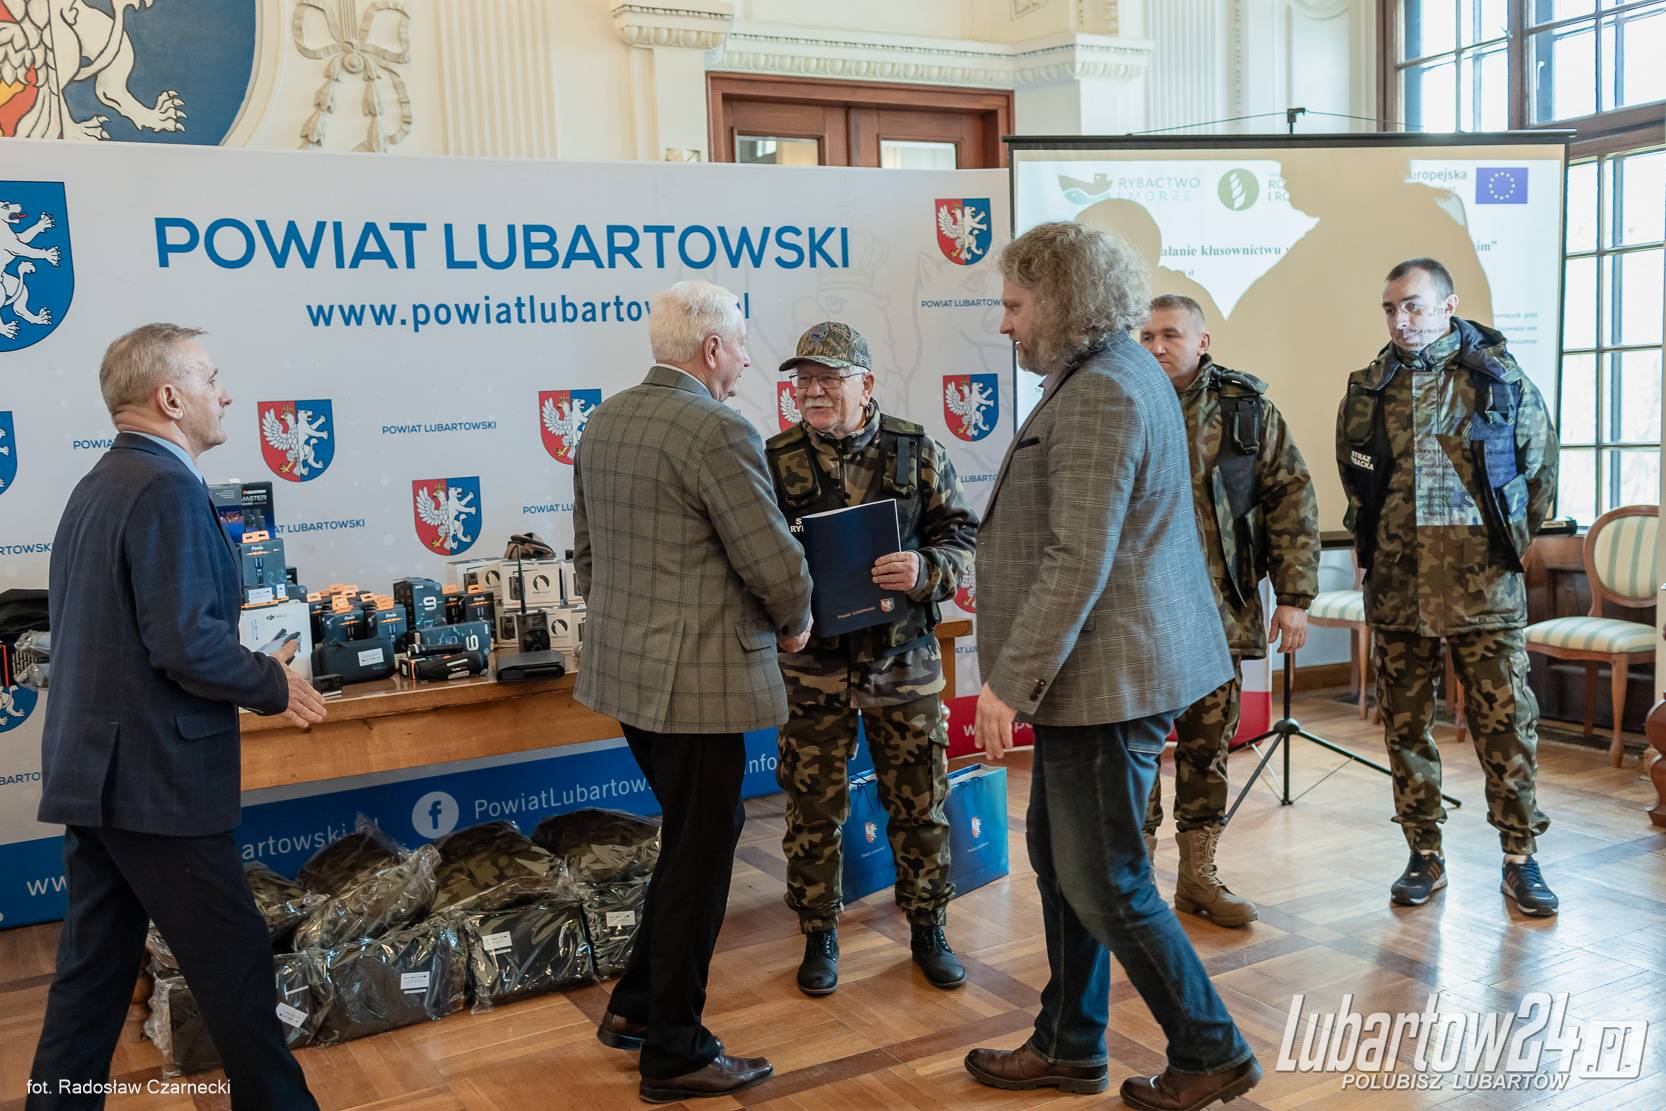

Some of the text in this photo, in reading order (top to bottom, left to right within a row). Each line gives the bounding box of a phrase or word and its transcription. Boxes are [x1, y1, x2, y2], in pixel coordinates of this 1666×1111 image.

[1118, 177, 1200, 189] RYBACTWO
[1128, 190, 1192, 201] MORZE
[155, 217, 849, 270] POWIAT LUBARTOWSKI
[1200, 244, 1281, 257] kłusownictwu
[921, 298, 1002, 308] POWIAT LUBARTOW
[382, 421, 497, 435] POWIAT LUBARTOWSKI
[73, 439, 114, 449] POWIA
[523, 504, 560, 514] POWIAT
[287, 519, 365, 533] LUBARTOWSKI
